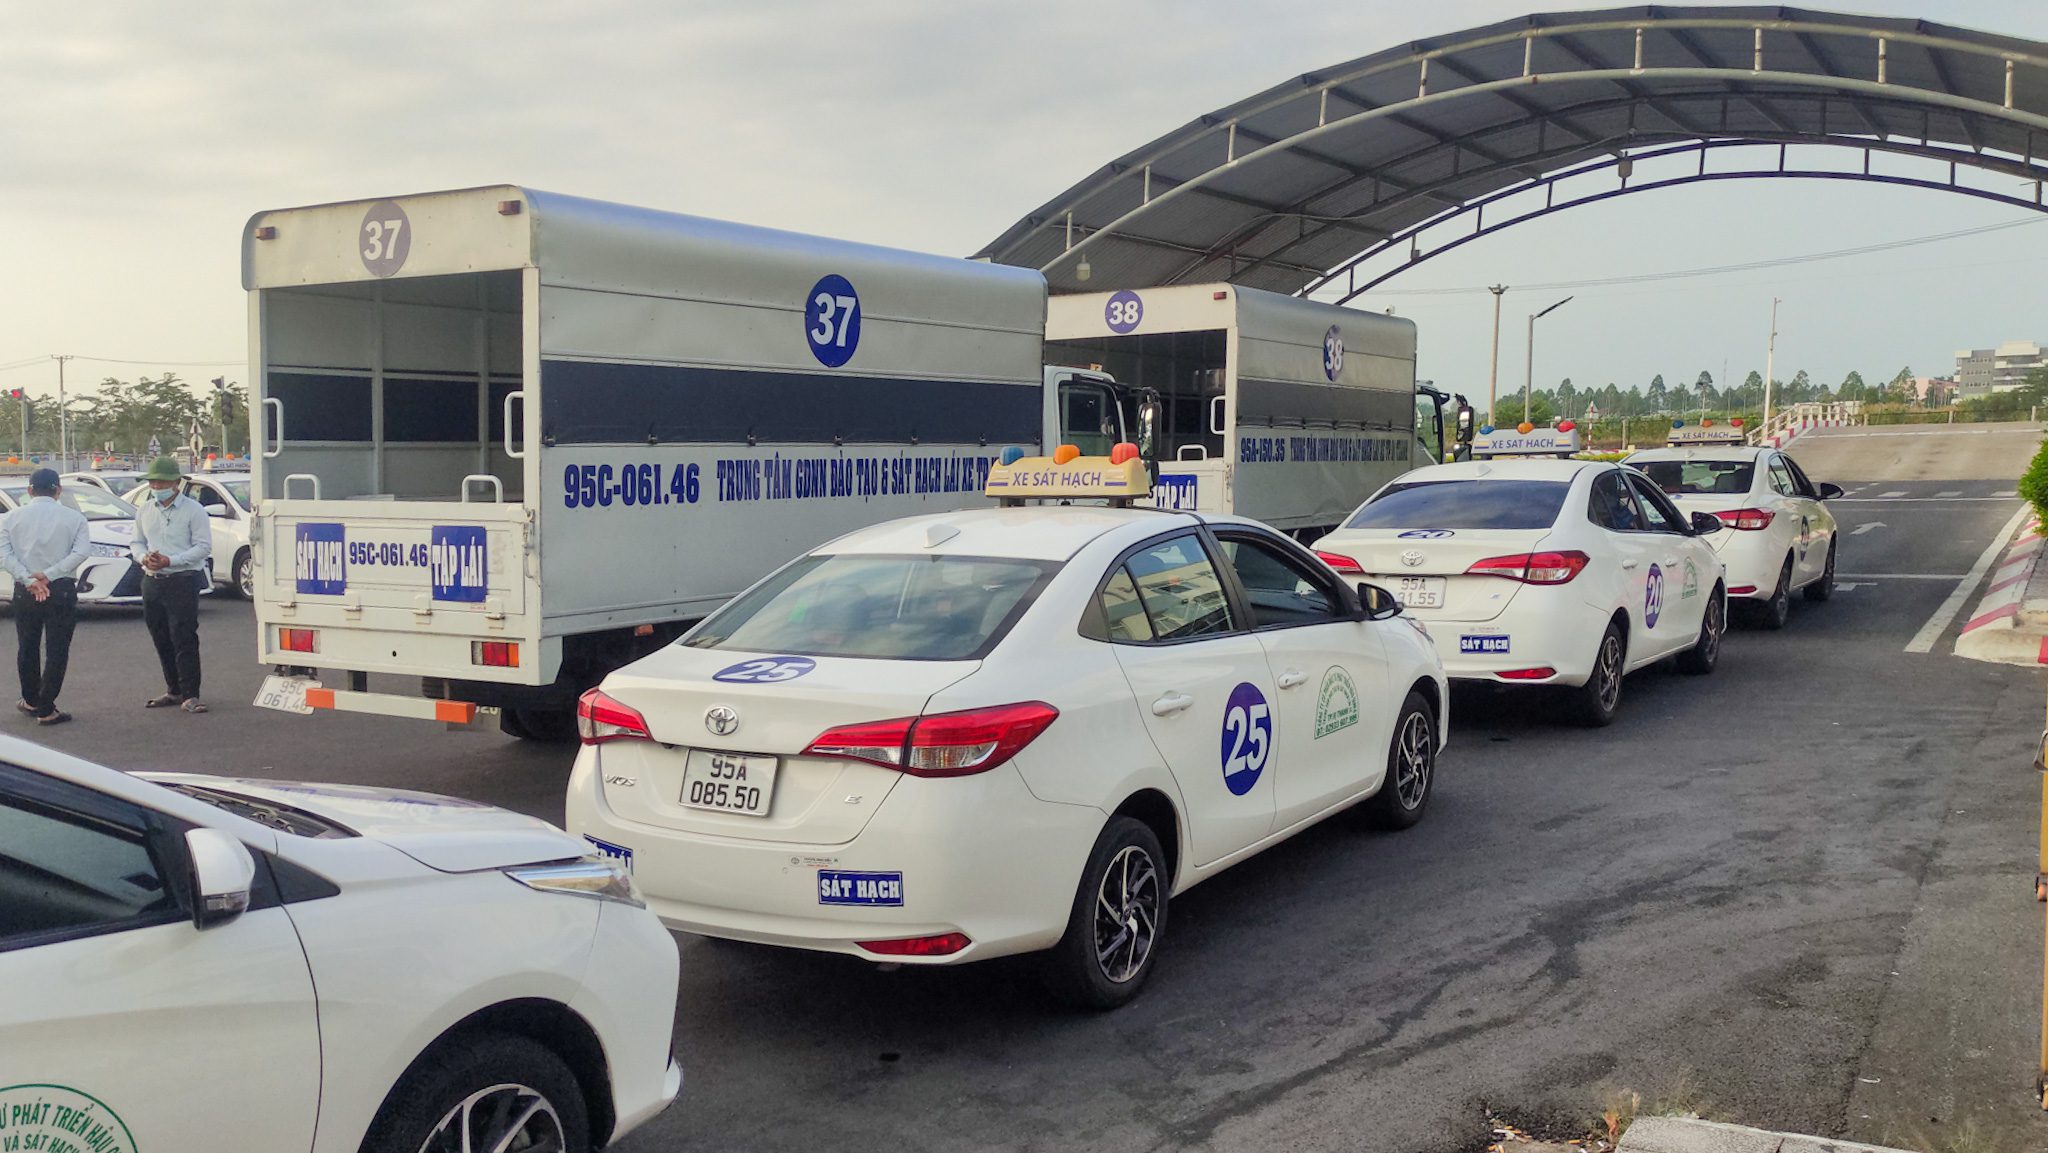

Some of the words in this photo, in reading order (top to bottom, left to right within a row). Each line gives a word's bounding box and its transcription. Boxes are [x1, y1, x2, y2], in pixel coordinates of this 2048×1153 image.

[363, 219, 403, 261] 37
[811, 292, 856, 347] 37
[1109, 299, 1139, 325] 38
[1325, 338, 1343, 371] 38
[564, 462, 701, 508] 95C-061.46
[716, 459, 760, 501] TRUNG
[764, 451, 792, 500] TÂM
[796, 458, 827, 499] GDNN
[856, 458, 878, 504] TẠO
[881, 457, 889, 496] &
[891, 449, 912, 495] SÁT
[914, 456, 942, 501] HẠCH
[943, 449, 960, 493] LÁI
[961, 456, 974, 492] XE
[1012, 472, 1028, 487] XE
[1032, 468, 1057, 487] SÁT
[1061, 471, 1101, 489] HẠCH
[1178, 479, 1195, 509] LÁI
[296, 531, 315, 581] SÁT
[317, 540, 343, 589] HẠCH
[349, 541, 428, 568] 95C-061.46
[432, 536, 458, 595] TẬP
[460, 535, 484, 587] LÁI
[1646, 574, 1663, 616] 20
[1461, 636, 1481, 650] SÁT
[717, 661, 815, 682] 25
[1224, 703, 1268, 778] 25
[710, 755, 747, 781] 95A
[690, 780, 760, 811] 085.50
[820, 873, 852, 898] SÁT
[856, 879, 900, 903] HẠCH
[12, 1097, 51, 1127] PHÁT
[52, 1103, 95, 1137] TRIỂN
[4, 1130, 19, 1153] VÀ
[23, 1129, 49, 1152] SÁT
